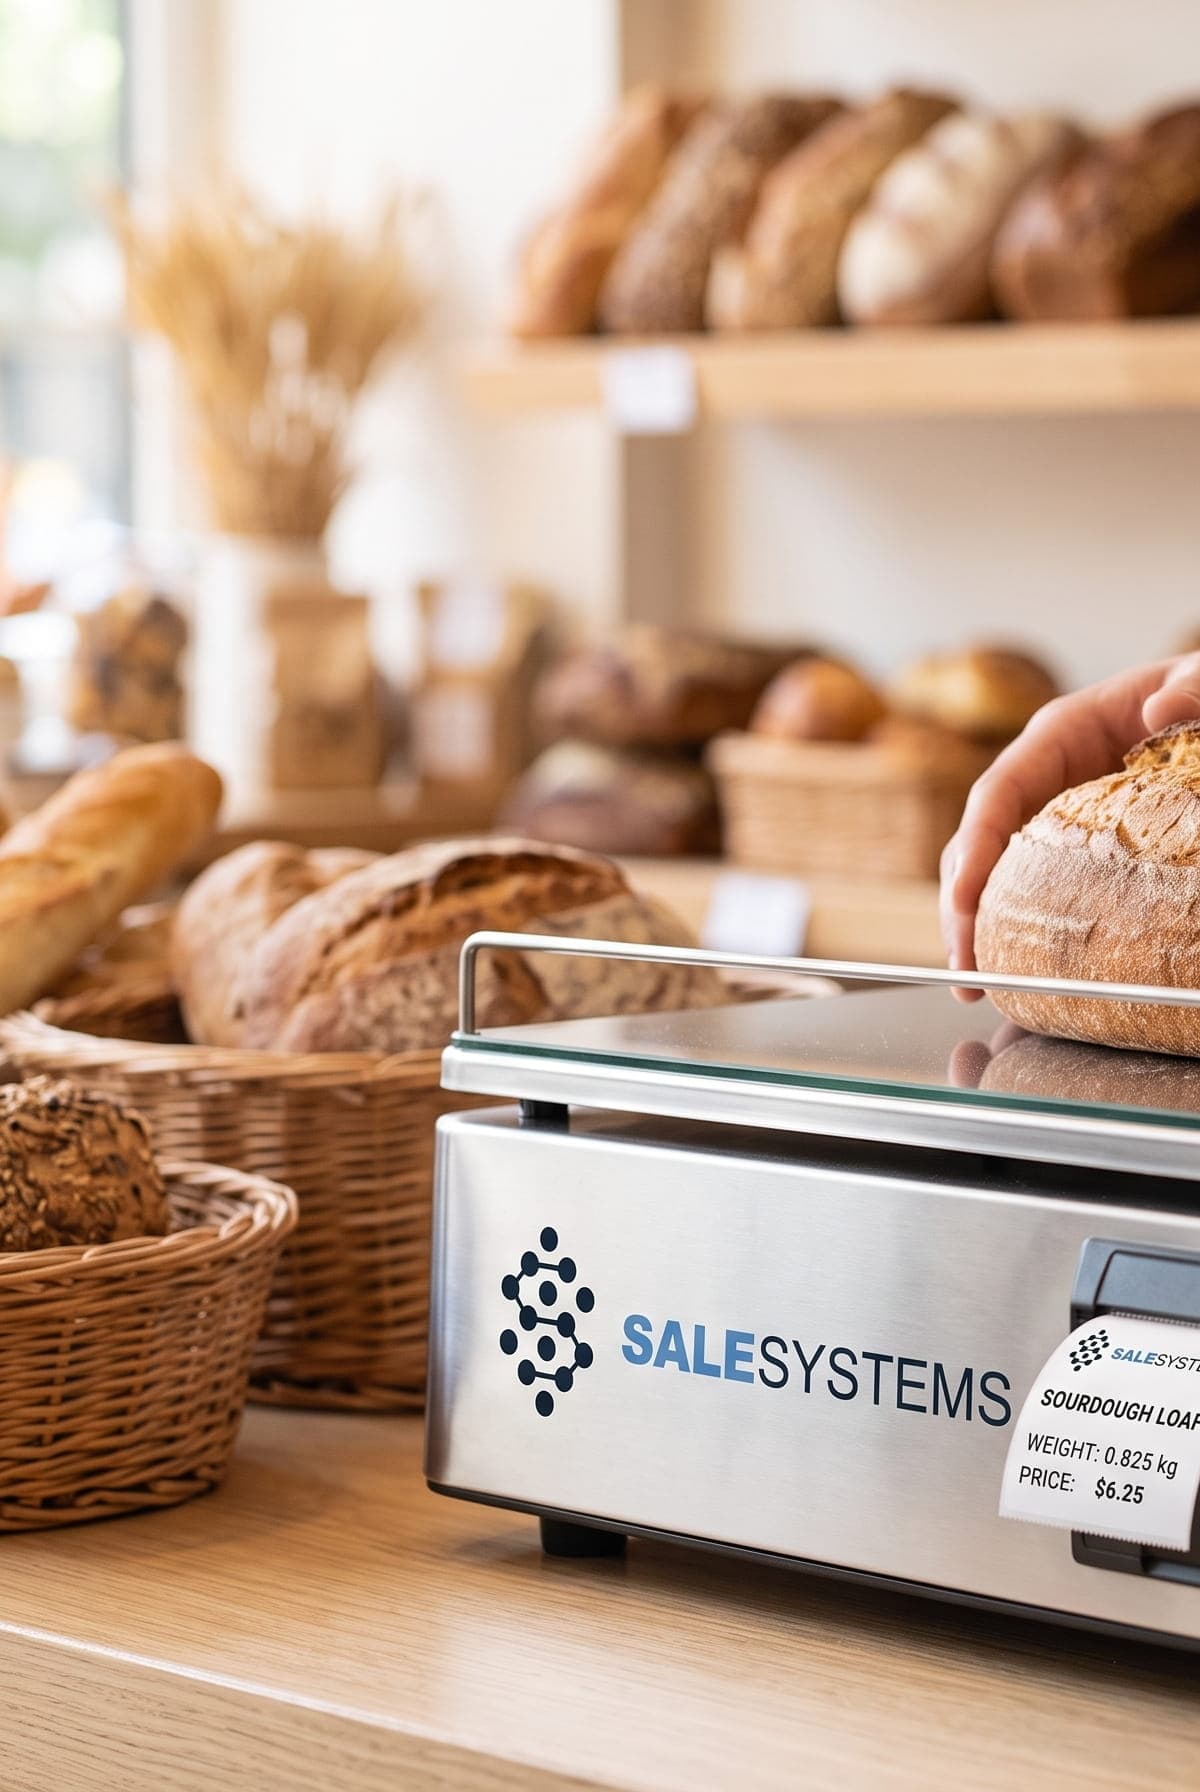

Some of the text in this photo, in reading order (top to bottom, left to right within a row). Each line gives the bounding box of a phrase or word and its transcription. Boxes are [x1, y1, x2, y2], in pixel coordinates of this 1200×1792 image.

[621, 1313, 1012, 1427] SALESYSTEMS
[1040, 1389, 1154, 1423] SOURDOUGH
[1027, 1432, 1179, 1480] WEIGHT: 0.825 kg
[1018, 1465, 1145, 1505] PRICE: $6.25
